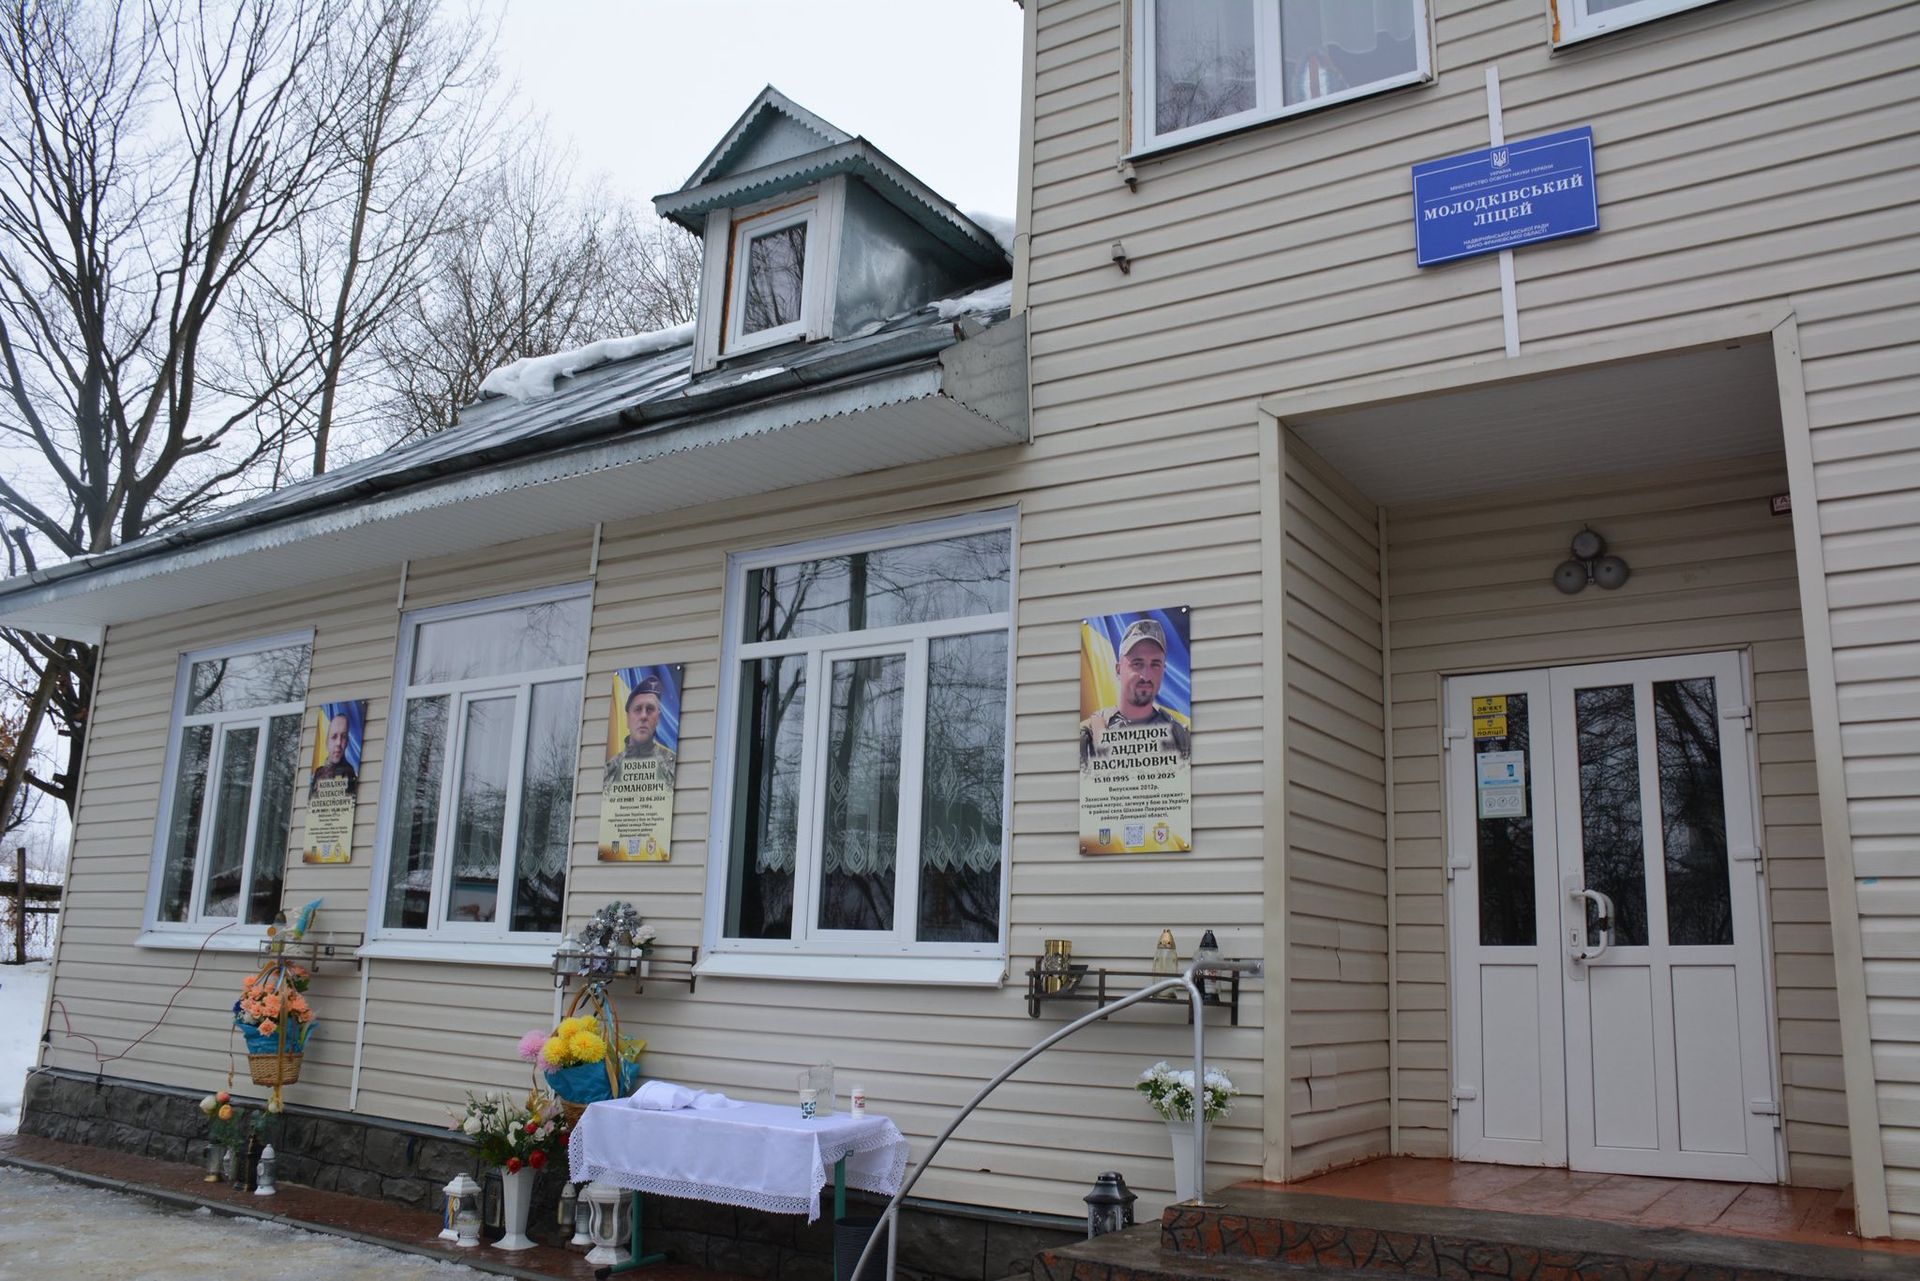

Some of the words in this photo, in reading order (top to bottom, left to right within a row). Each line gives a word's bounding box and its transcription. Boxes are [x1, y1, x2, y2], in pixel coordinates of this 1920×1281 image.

[1450, 178, 1488, 191] МІНІСТЕРСТВО
[1489, 174, 1509, 183] ОСВІТИ
[1531, 164, 1554, 173] УКРАЇНИ
[1490, 168, 1511, 176] УКРАЇНА
[1424, 173, 1584, 221] МОЛОДКІВСЬКИЙ
[1473, 202, 1532, 227] ЛІЦЕЙ
[1101, 728, 1168, 743] ДЕМИДЮК
[1111, 741, 1158, 756] АНДРІЙ
[624, 761, 656, 770] ЮЗЬКІВ
[1093, 756, 1177, 770] ВАСИЛЬОВИЧ
[623, 772, 655, 781] СТЕПАН
[613, 783, 664, 793] РОМАНОВИЧ
